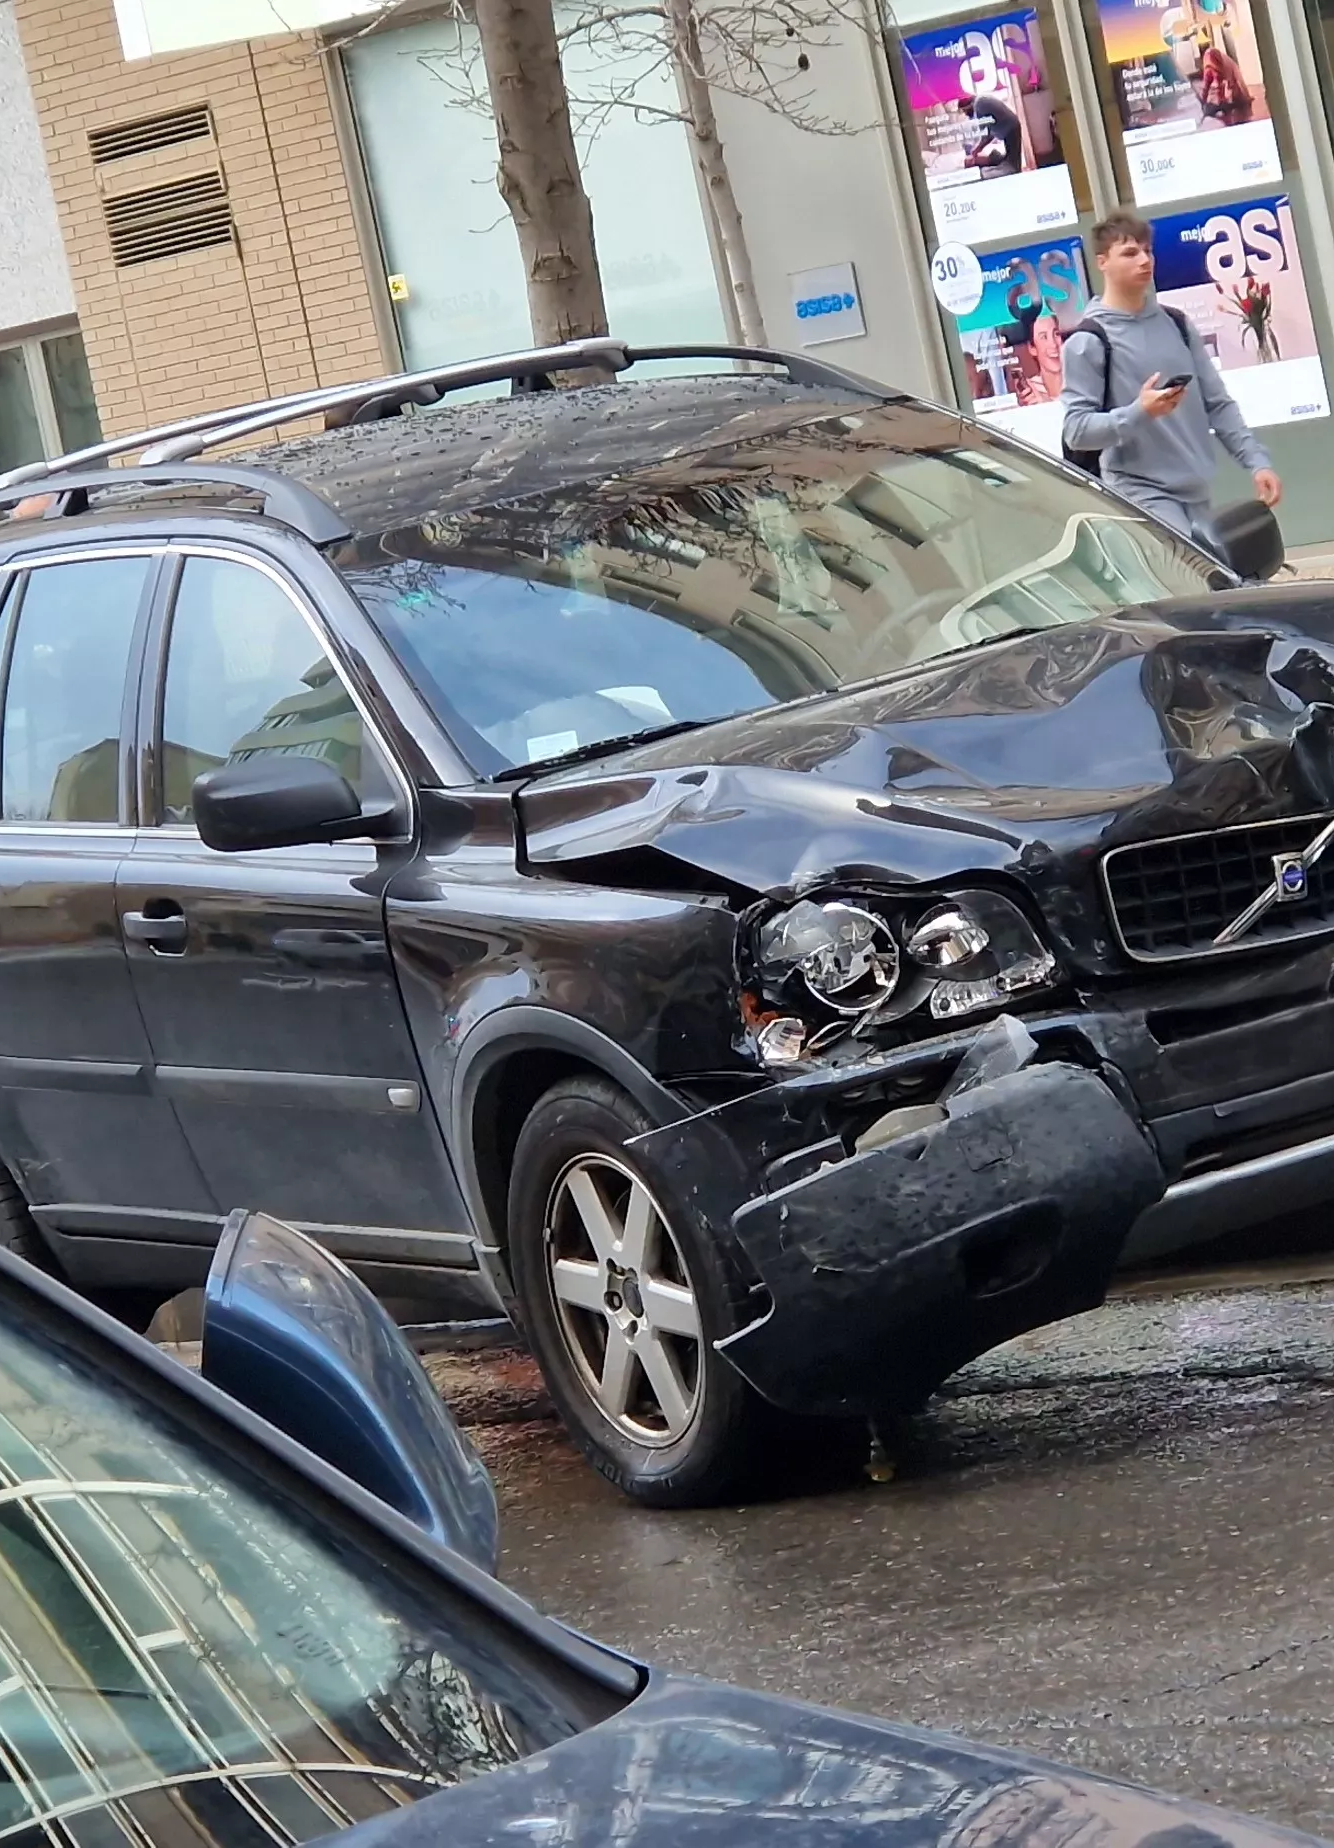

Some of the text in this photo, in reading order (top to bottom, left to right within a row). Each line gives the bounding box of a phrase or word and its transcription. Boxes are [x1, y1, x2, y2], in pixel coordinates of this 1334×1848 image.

[1140, 157, 1175, 174] 30,00€
[1207, 193, 1292, 282] así
[981, 264, 1012, 284] mejor
